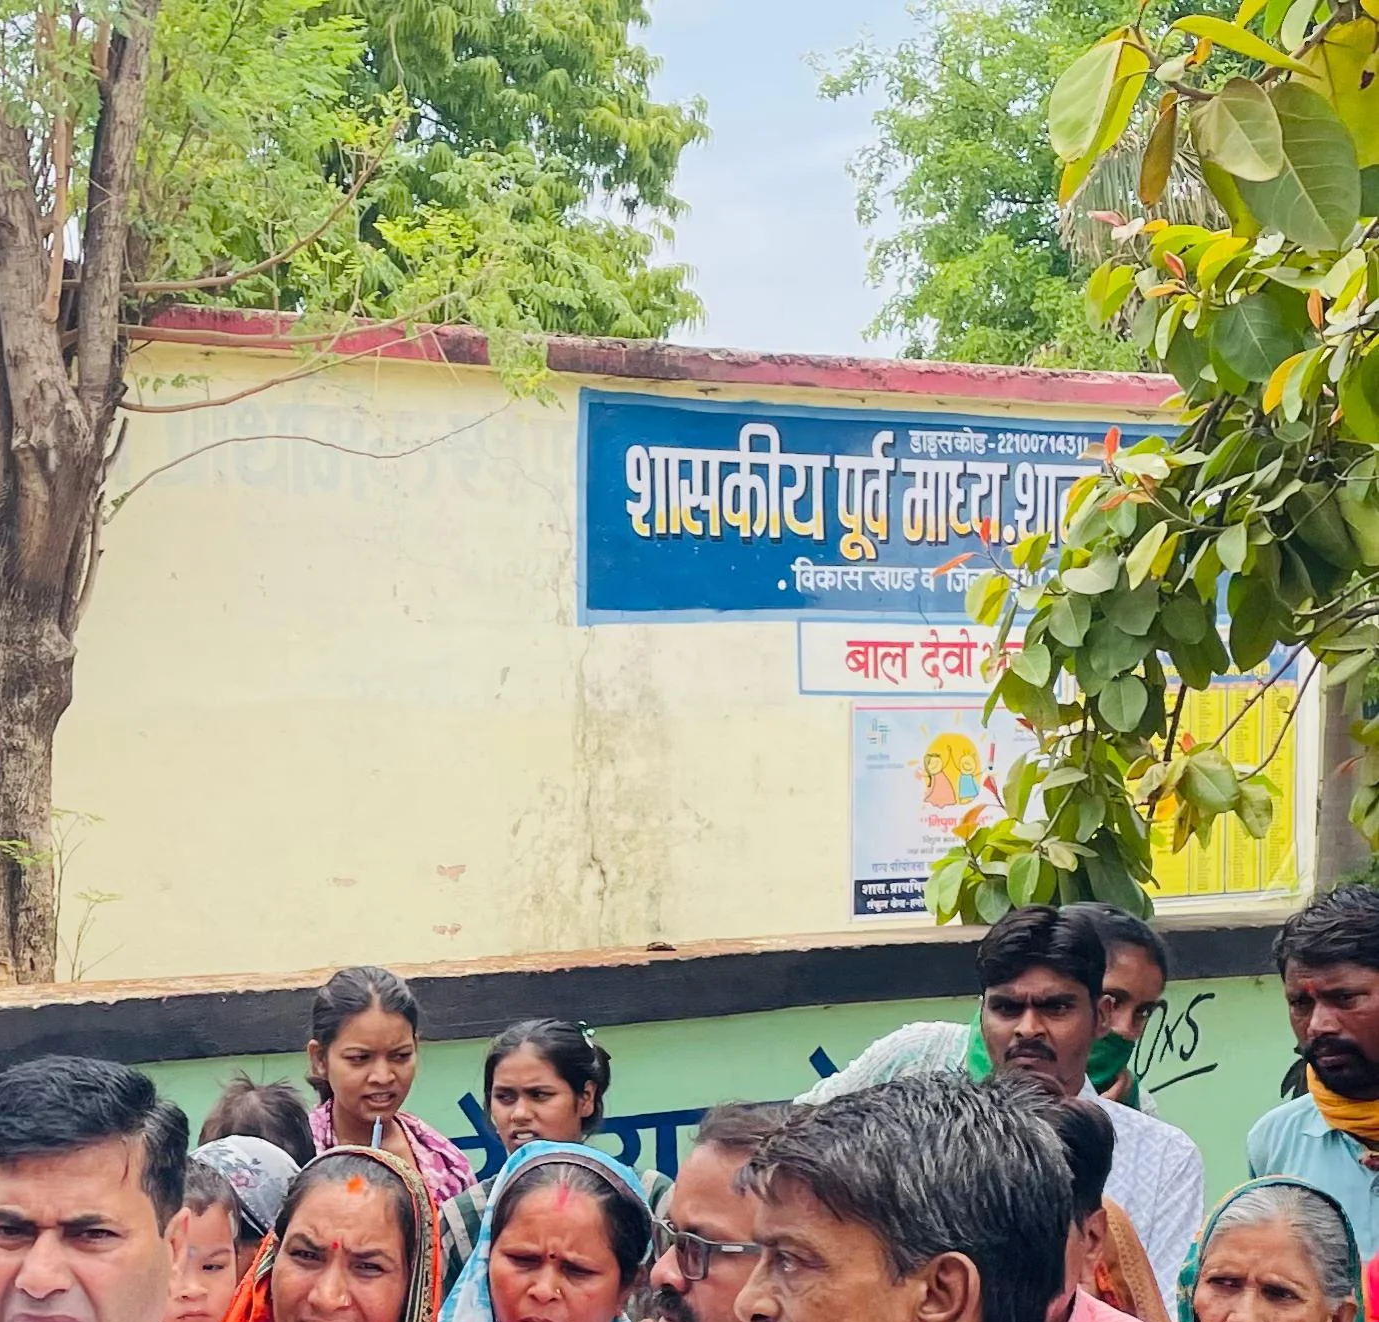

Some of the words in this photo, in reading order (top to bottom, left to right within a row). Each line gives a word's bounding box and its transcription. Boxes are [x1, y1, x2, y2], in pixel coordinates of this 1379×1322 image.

[625, 422, 830, 540] शासकीय
[834, 430, 895, 561] पूर्व
[791, 556, 864, 593] विकास
[868, 567, 917, 592] खण्ड
[845, 640, 914, 686] बाल
[920, 628, 977, 690] देवो
